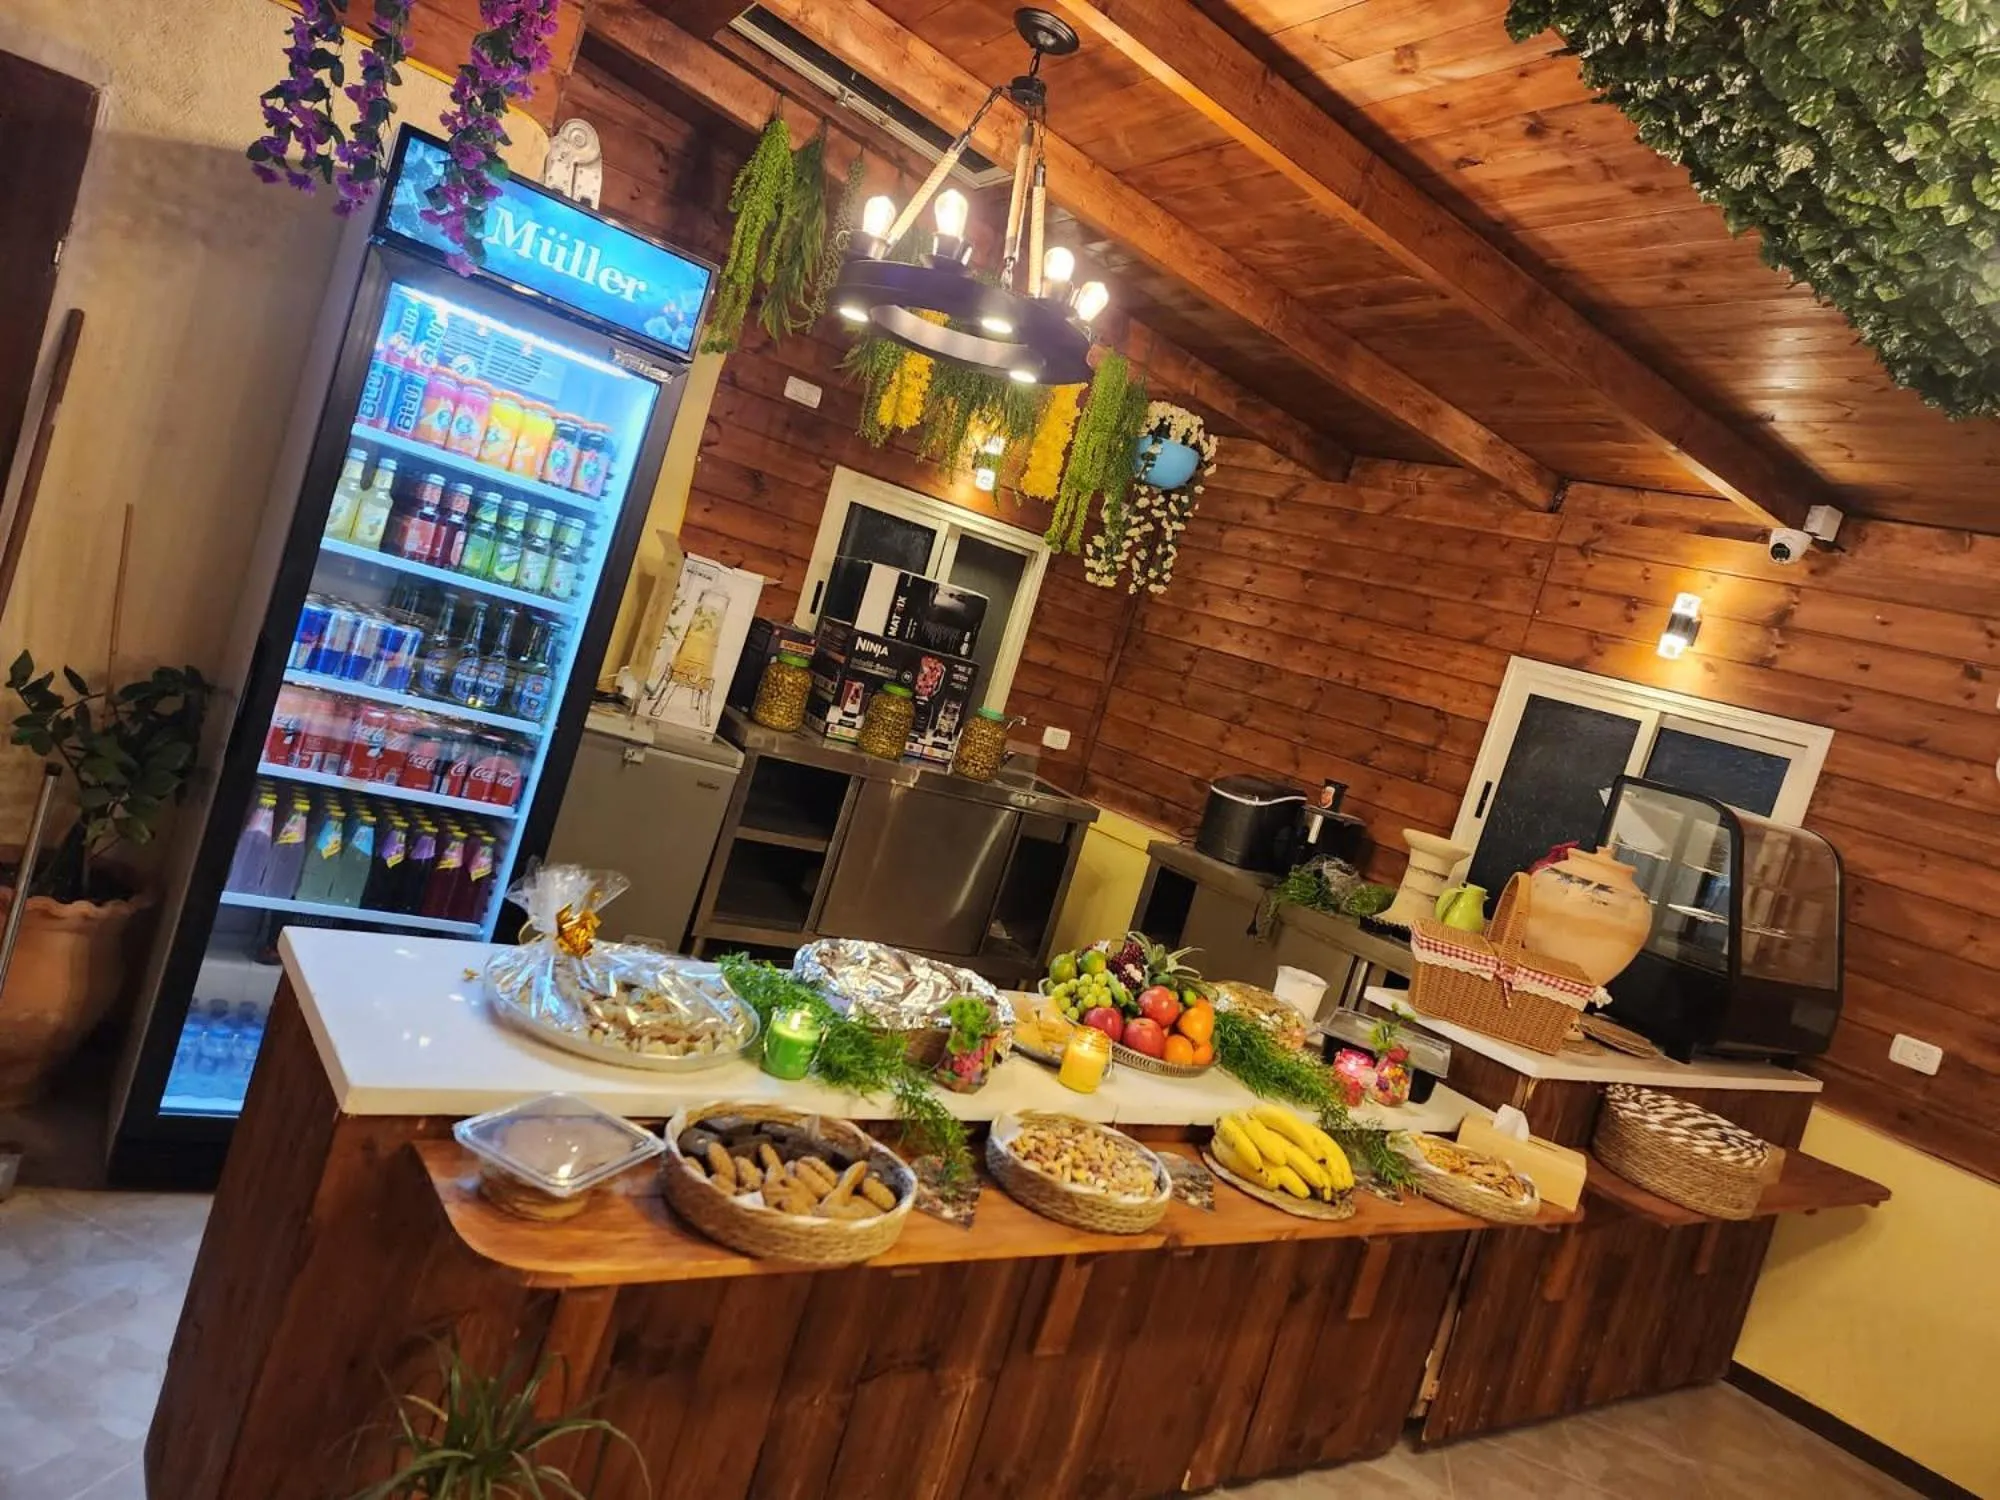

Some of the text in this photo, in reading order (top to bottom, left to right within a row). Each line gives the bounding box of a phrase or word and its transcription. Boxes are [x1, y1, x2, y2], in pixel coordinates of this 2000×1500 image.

[485, 206, 648, 303] Müller
[359, 371, 385, 419] BLU
[397, 383, 422, 432] BLU
[855, 637, 889, 658] NINJA
